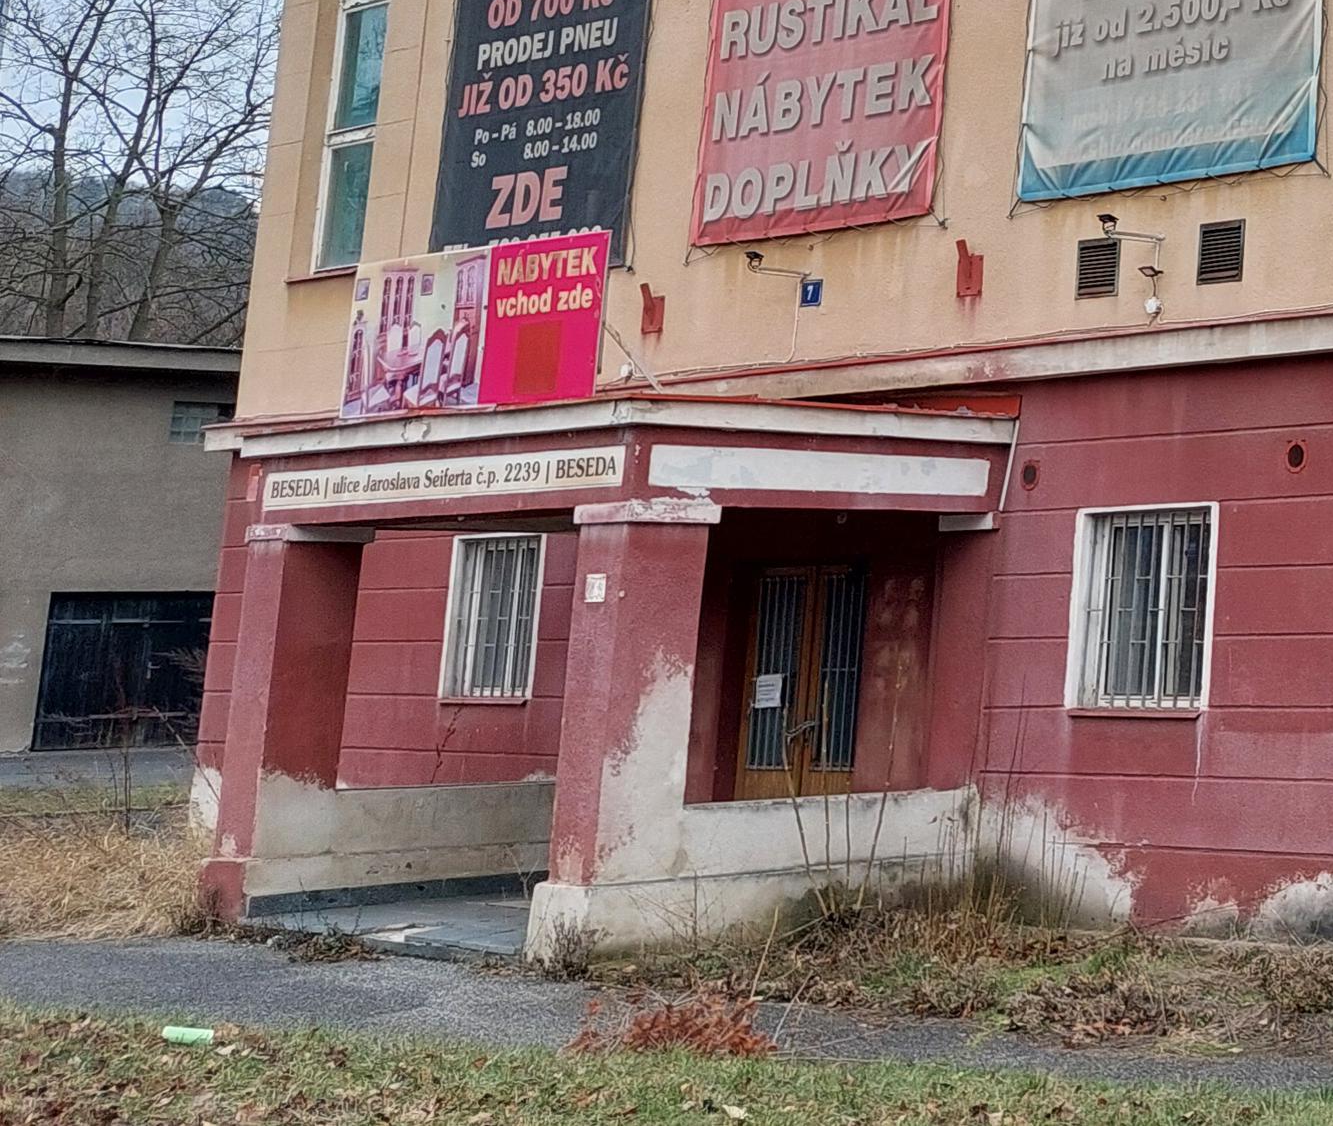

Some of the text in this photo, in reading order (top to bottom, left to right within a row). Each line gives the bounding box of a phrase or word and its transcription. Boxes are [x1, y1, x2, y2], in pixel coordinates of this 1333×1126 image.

[477, 17, 618, 70] PRODEJ PNEU
[1094, 8, 1127, 43] od
[458, 53, 630, 118] JIŽ OD 350 Kč
[1101, 55, 1133, 82] na
[712, 54, 934, 142] NÁBYTEK
[474, 129, 489, 145] Po
[501, 122, 516, 141] Pá
[526, 117, 552, 137] 8.00
[564, 109, 600, 130] 18.00
[471, 151, 486, 168] So
[523, 141, 549, 160] 8.00
[561, 132, 597, 153] 14.00
[485, 166, 568, 229] ZDE
[703, 137, 936, 223] DOPLŇKY
[496, 248, 598, 286] NÁBYTEK
[496, 282, 593, 318] vchod zde
[271, 478, 320, 499] BESEDA
[332, 475, 360, 495] ulice
[363, 471, 420, 493] Jaroslava
[424, 467, 472, 489] Seiferta
[476, 465, 500, 489] č.p.
[504, 461, 540, 482] 2239
[555, 456, 617, 479] BESEDA
